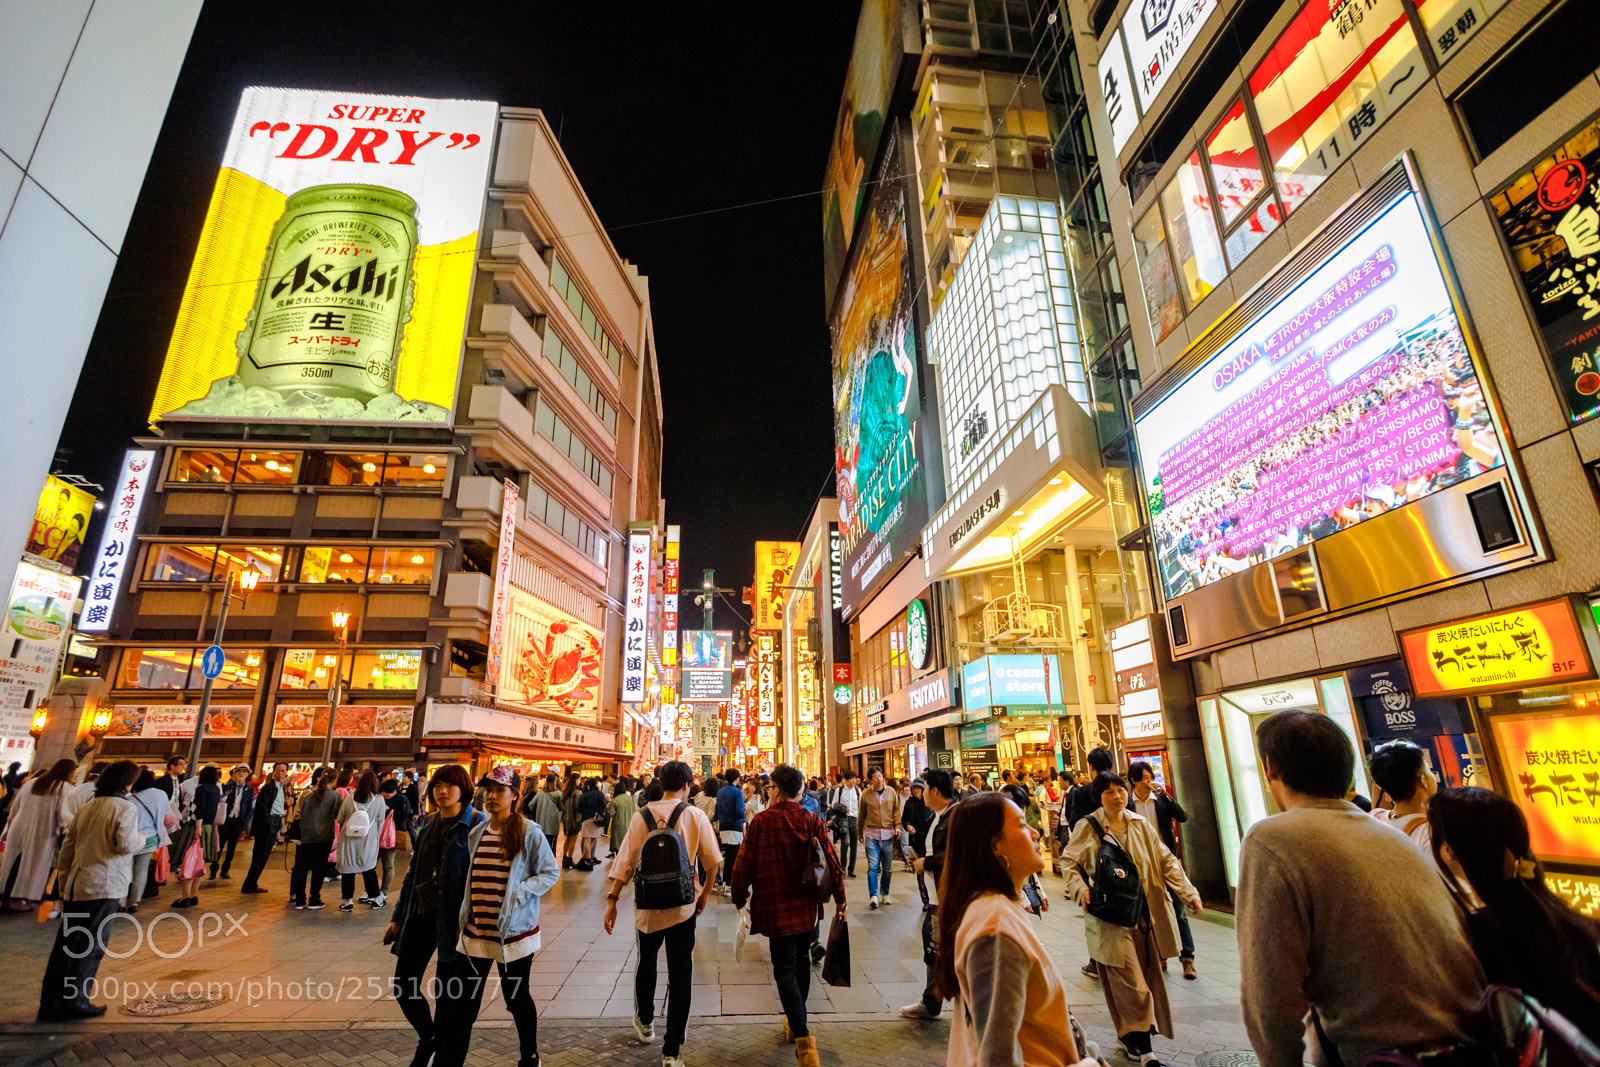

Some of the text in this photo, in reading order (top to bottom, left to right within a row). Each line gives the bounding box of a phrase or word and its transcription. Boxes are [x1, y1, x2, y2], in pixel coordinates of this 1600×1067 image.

[1336, 0, 1377, 40] 鶴
[328, 103, 426, 124] SUPER
[298, 221, 391, 249] ASAHI BREWERIES LIMITED
[270, 253, 399, 303] Asahi
[1542, 277, 1577, 300] torizo
[309, 312, 346, 331] 生
[288, 335, 361, 347] スーパードライ
[304, 346, 338, 355] 生ビール
[301, 367, 333, 378] 350ml
[1212, 340, 1262, 392] OSAKA
[1366, 449, 1401, 475] FIRST
[1403, 426, 1450, 458] STORY
[840, 475, 885, 566] PARADISE
[888, 421, 917, 491] CITY
[114, 477, 140, 533] 本場の味
[630, 560, 645, 608] 本場の味
[1437, 616, 1525, 644] 炭火焼だいにんぐ
[837, 668, 848, 680] 本
[1552, 660, 1576, 672] B1F
[1372, 680, 1393, 690] COFFEE
[1470, 670, 1517, 684] watamin-chi
[909, 679, 946, 710] TSUTAYA
[1006, 680, 1045, 692] store
[864, 702, 885, 717] STARBUCKS
[993, 707, 1003, 716] 3F
[1384, 710, 1416, 724] BOSS
[868, 713, 882, 727] COFFEE
[1525, 750, 1600, 766] 炭火焼だい
